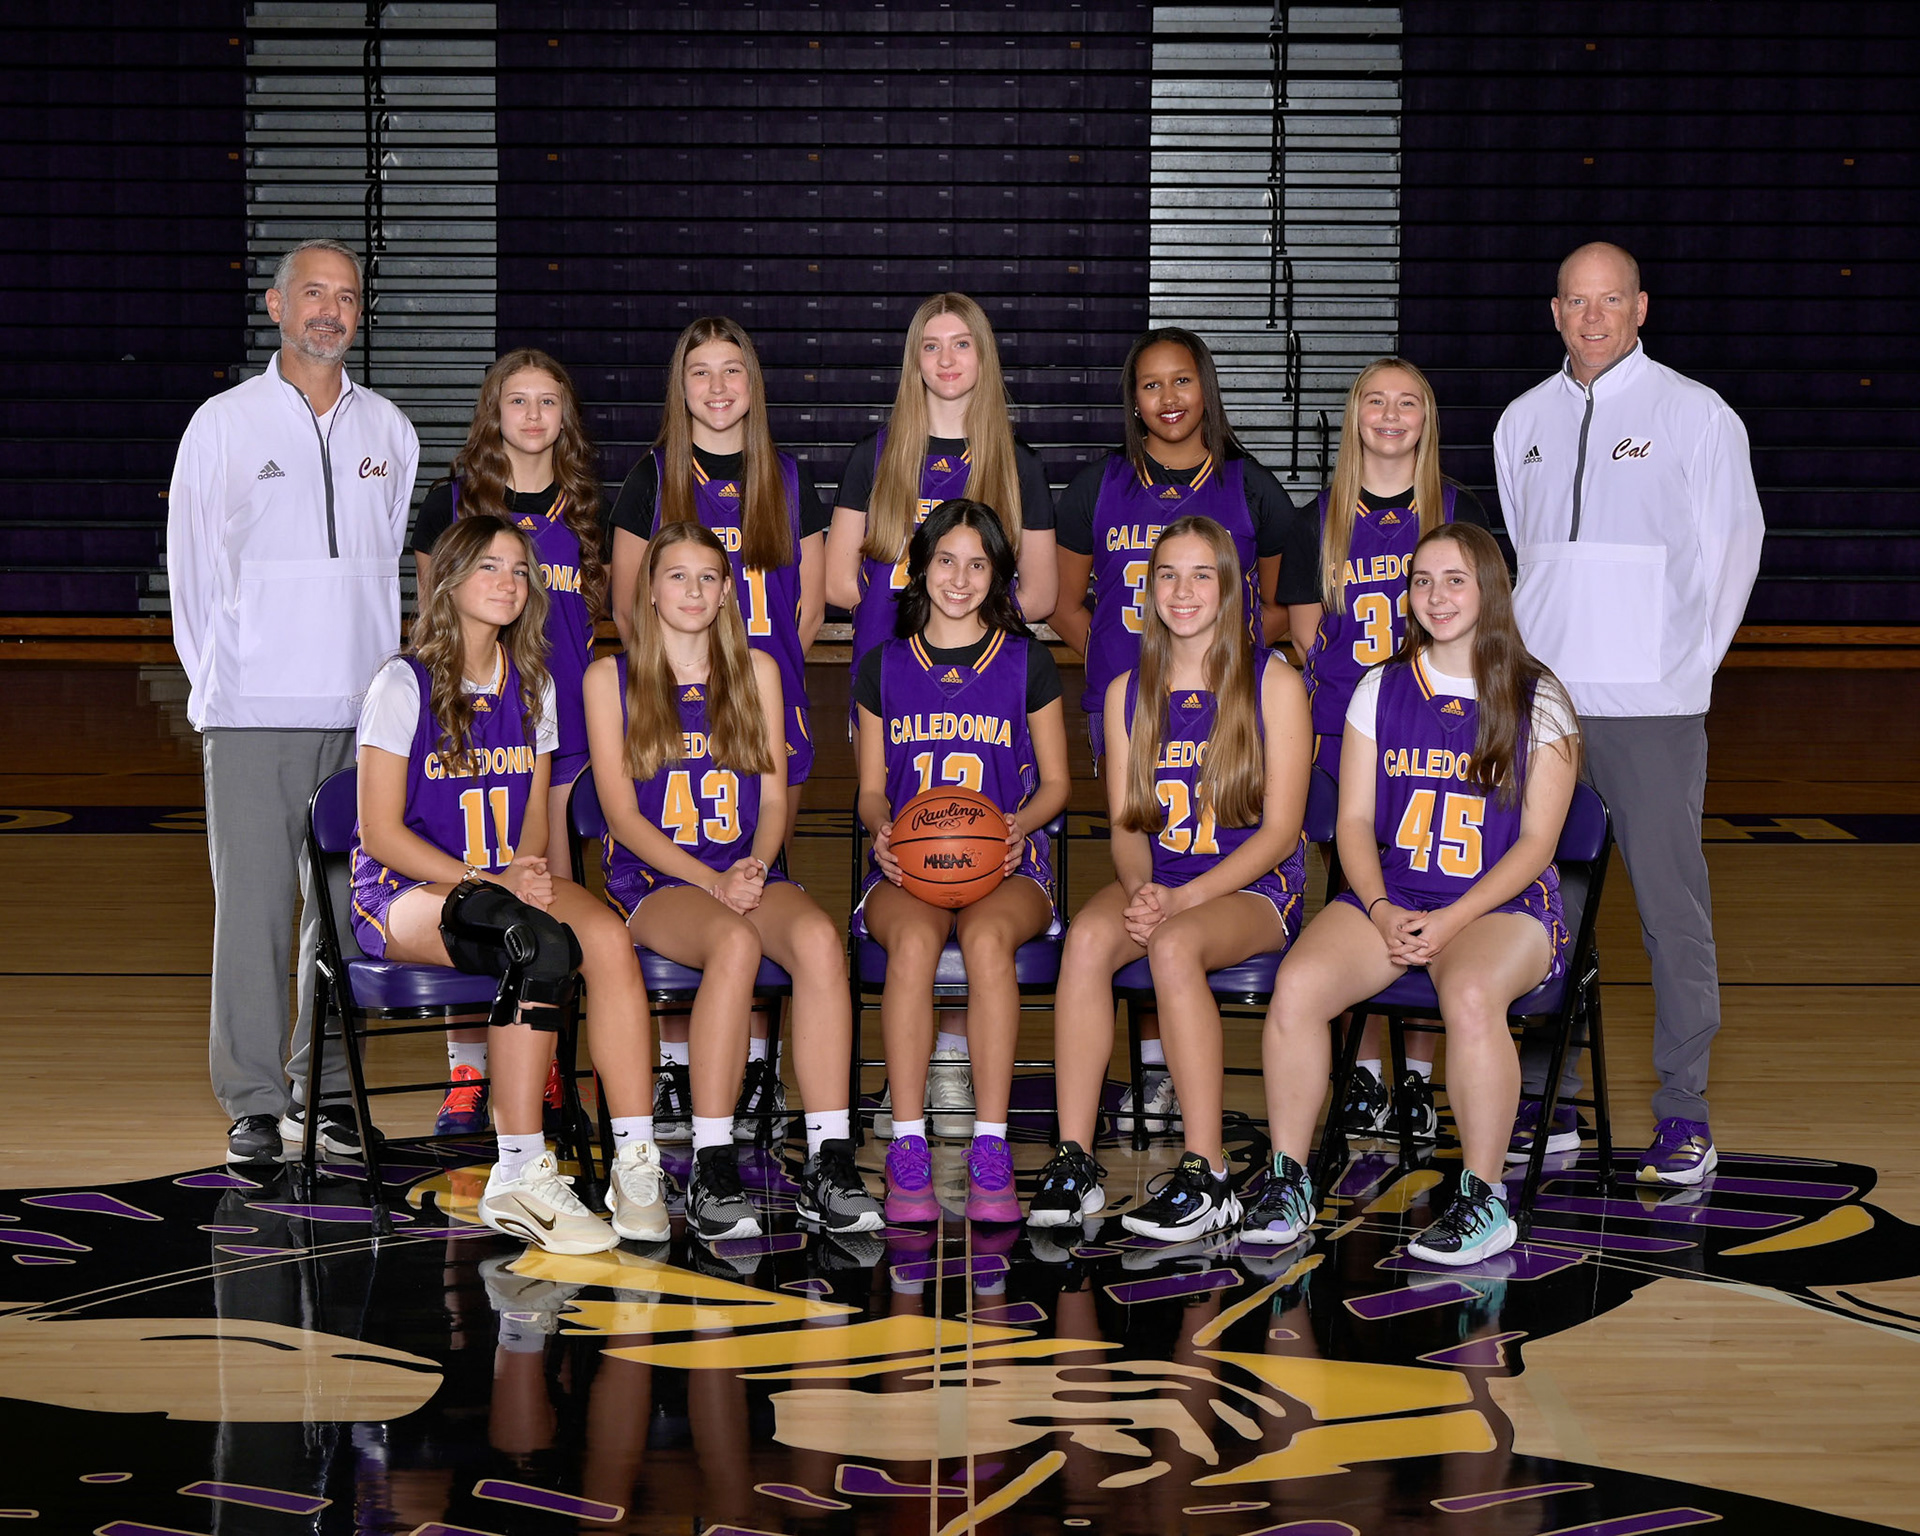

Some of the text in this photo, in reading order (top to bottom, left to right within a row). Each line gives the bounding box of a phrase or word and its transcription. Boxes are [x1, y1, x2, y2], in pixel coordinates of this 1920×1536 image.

[1523, 456, 1543, 465] adidas
[1611, 437, 1651, 461] Cal
[257, 470, 286, 480] adidas
[358, 456, 388, 479] Cal
[940, 676, 963, 684] adidas
[1440, 707, 1465, 716] adidas
[890, 711, 1012, 748] CALEDONIA
[661, 769, 743, 846] 43
[911, 801, 987, 832] Rawlings
[459, 786, 515, 869] 11
[1395, 788, 1487, 879] 45
[923, 852, 973, 870] MHSAA
